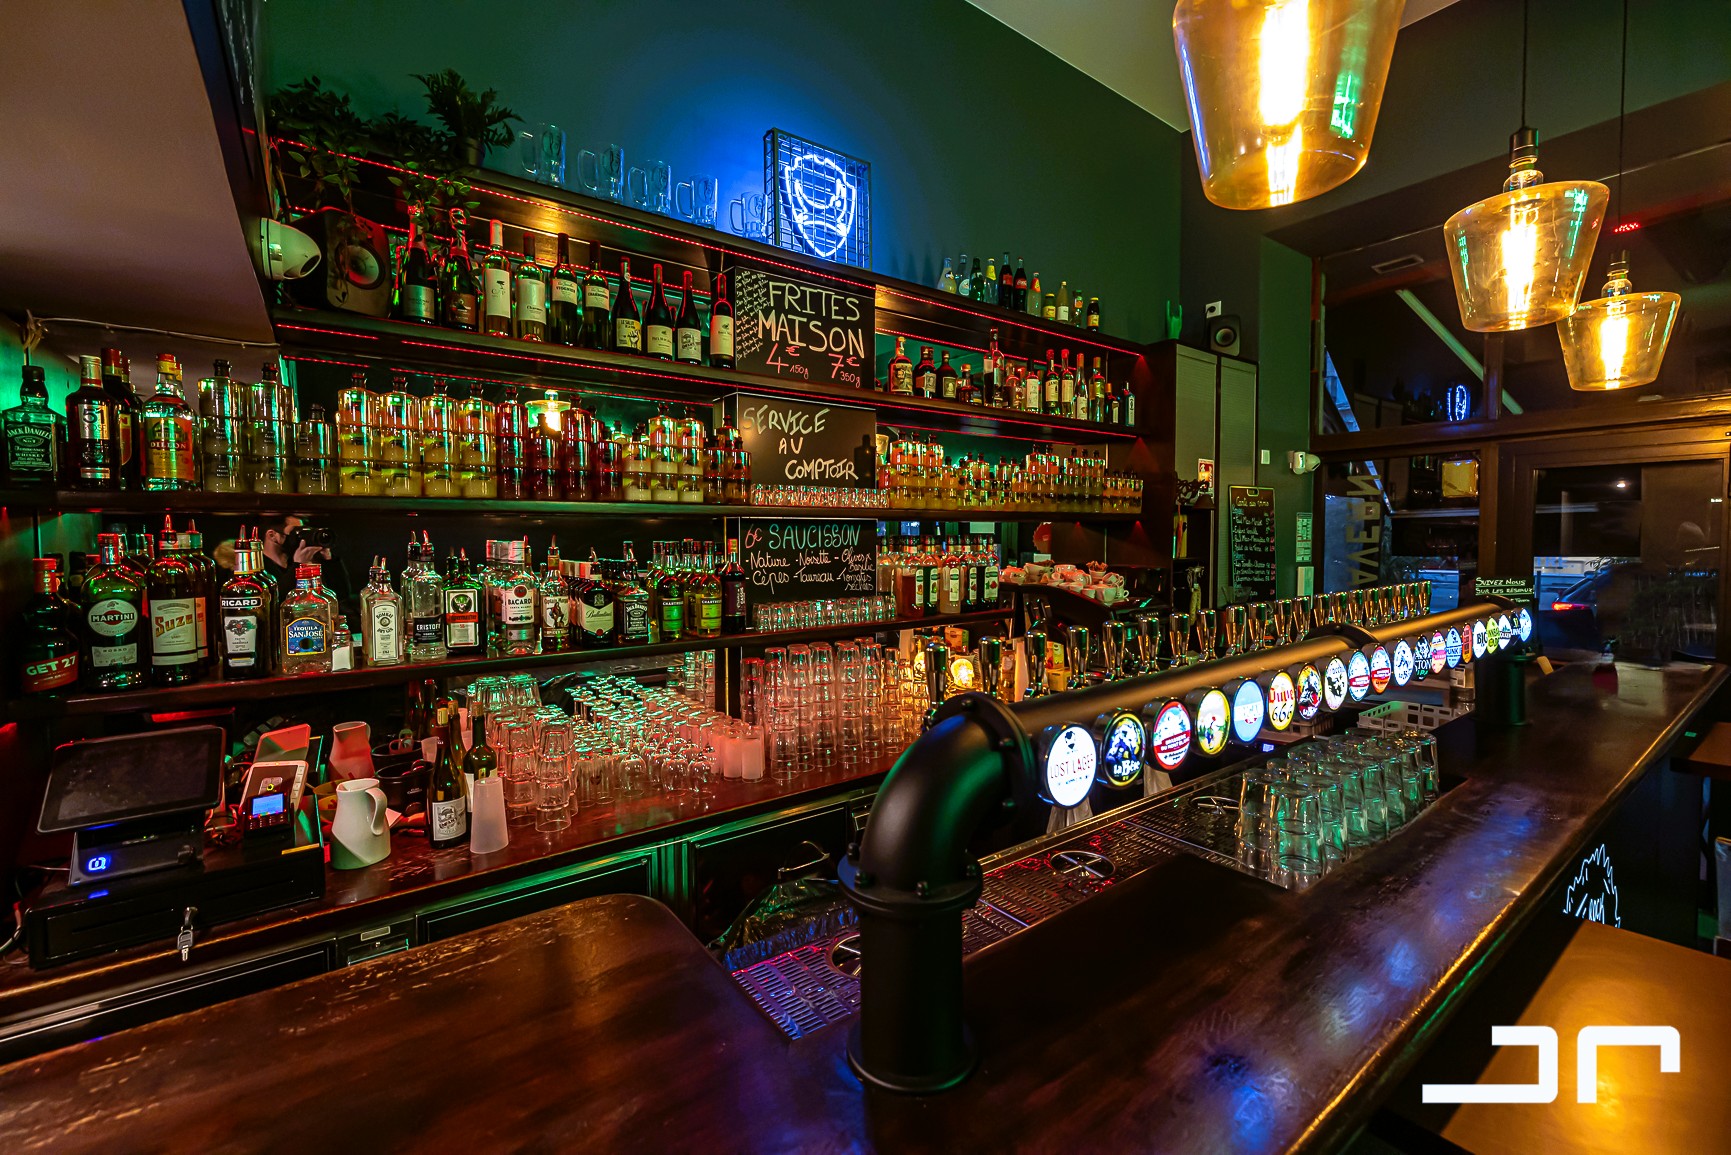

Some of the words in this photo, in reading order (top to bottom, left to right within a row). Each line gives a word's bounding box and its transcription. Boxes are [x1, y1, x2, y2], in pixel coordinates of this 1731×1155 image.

[769, 281, 860, 321] FRITES
[758, 309, 865, 359] MAISON
[790, 364, 809, 380] 150g
[840, 371, 861, 389] 350g
[743, 404, 830, 435] SERVICE
[778, 436, 804, 455] AU
[785, 458, 859, 480] COMPTOIR
[745, 523, 763, 549] 6€
[768, 523, 861, 550] SAUCISSON
[750, 550, 790, 569] Nature
[799, 549, 831, 566] Noisette
[752, 568, 790, 595] Cèpes
[796, 566, 834, 583] Taureau
[1475, 577, 1503, 586] SUIVEZ
[222, 599, 258, 607] RICARD
[92, 613, 134, 622] MARTINI
[26, 661, 59, 676] GET
[61, 655, 76, 668] 27
[1050, 761, 1069, 778] LOST
